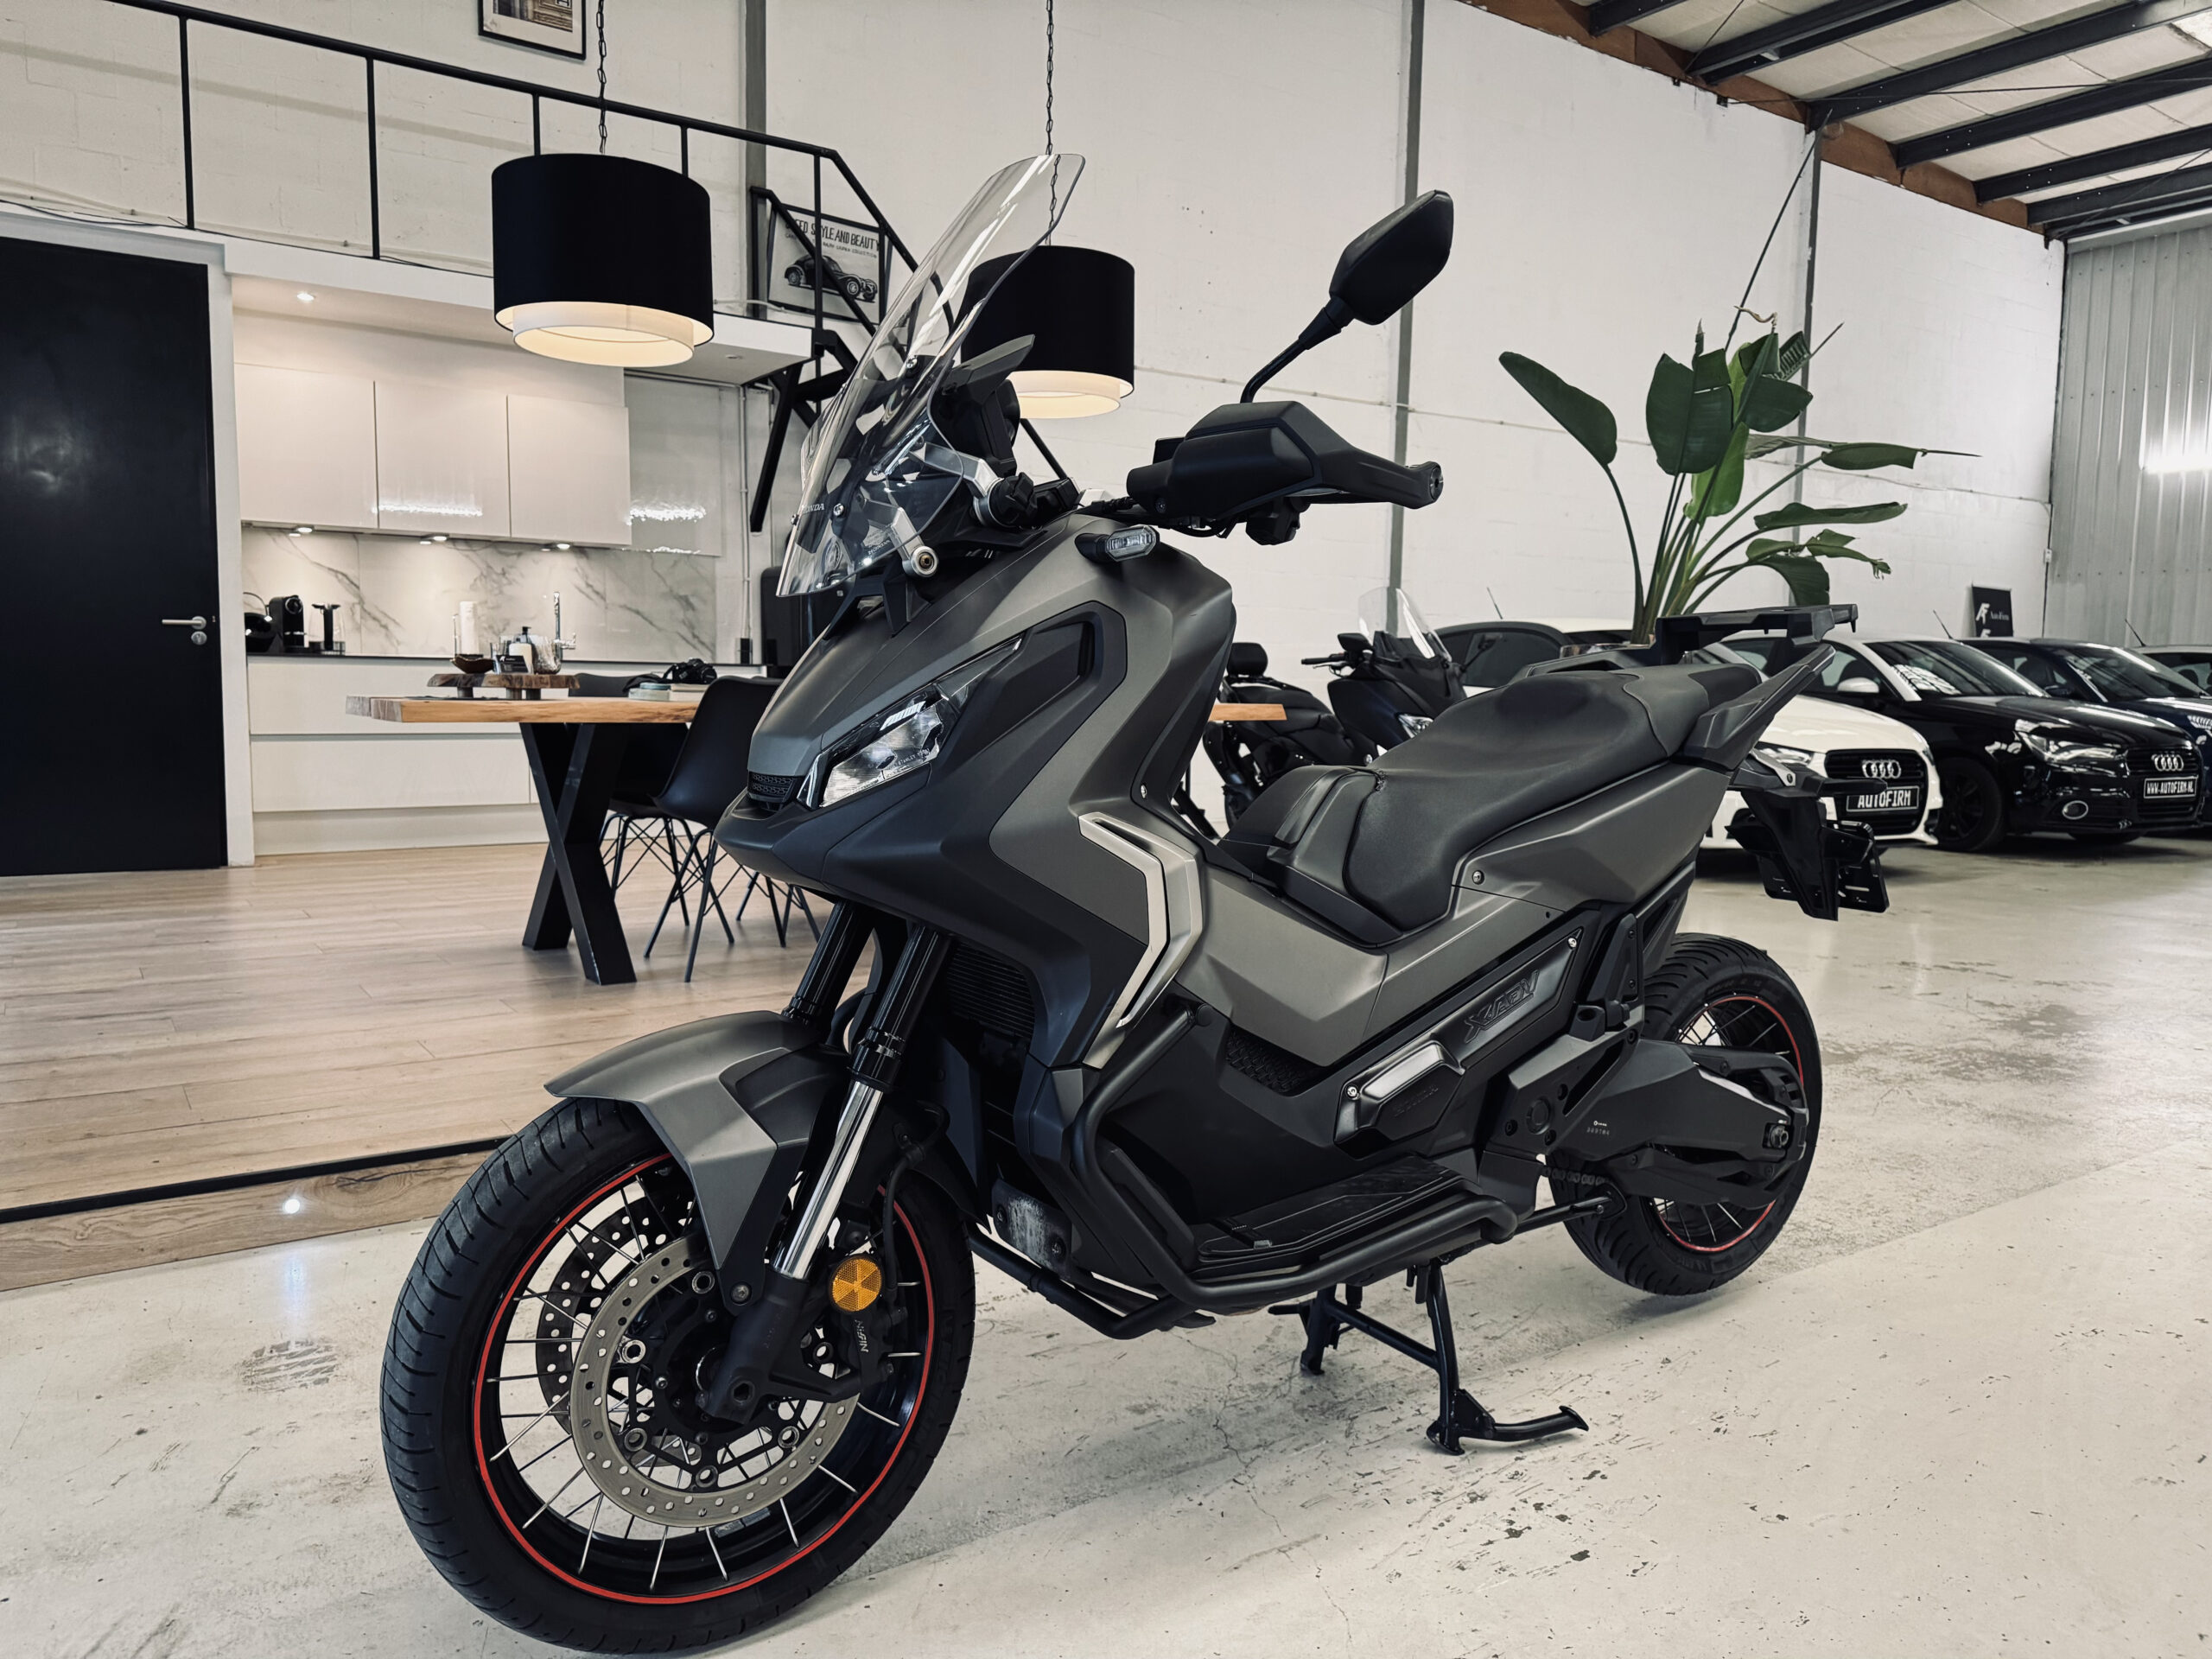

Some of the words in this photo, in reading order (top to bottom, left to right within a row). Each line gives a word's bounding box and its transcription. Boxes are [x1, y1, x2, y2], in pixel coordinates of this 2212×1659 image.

[810, 223, 835, 240] SYLE
[835, 229, 850, 244] AND
[850, 233, 880, 251] BEAUTY
